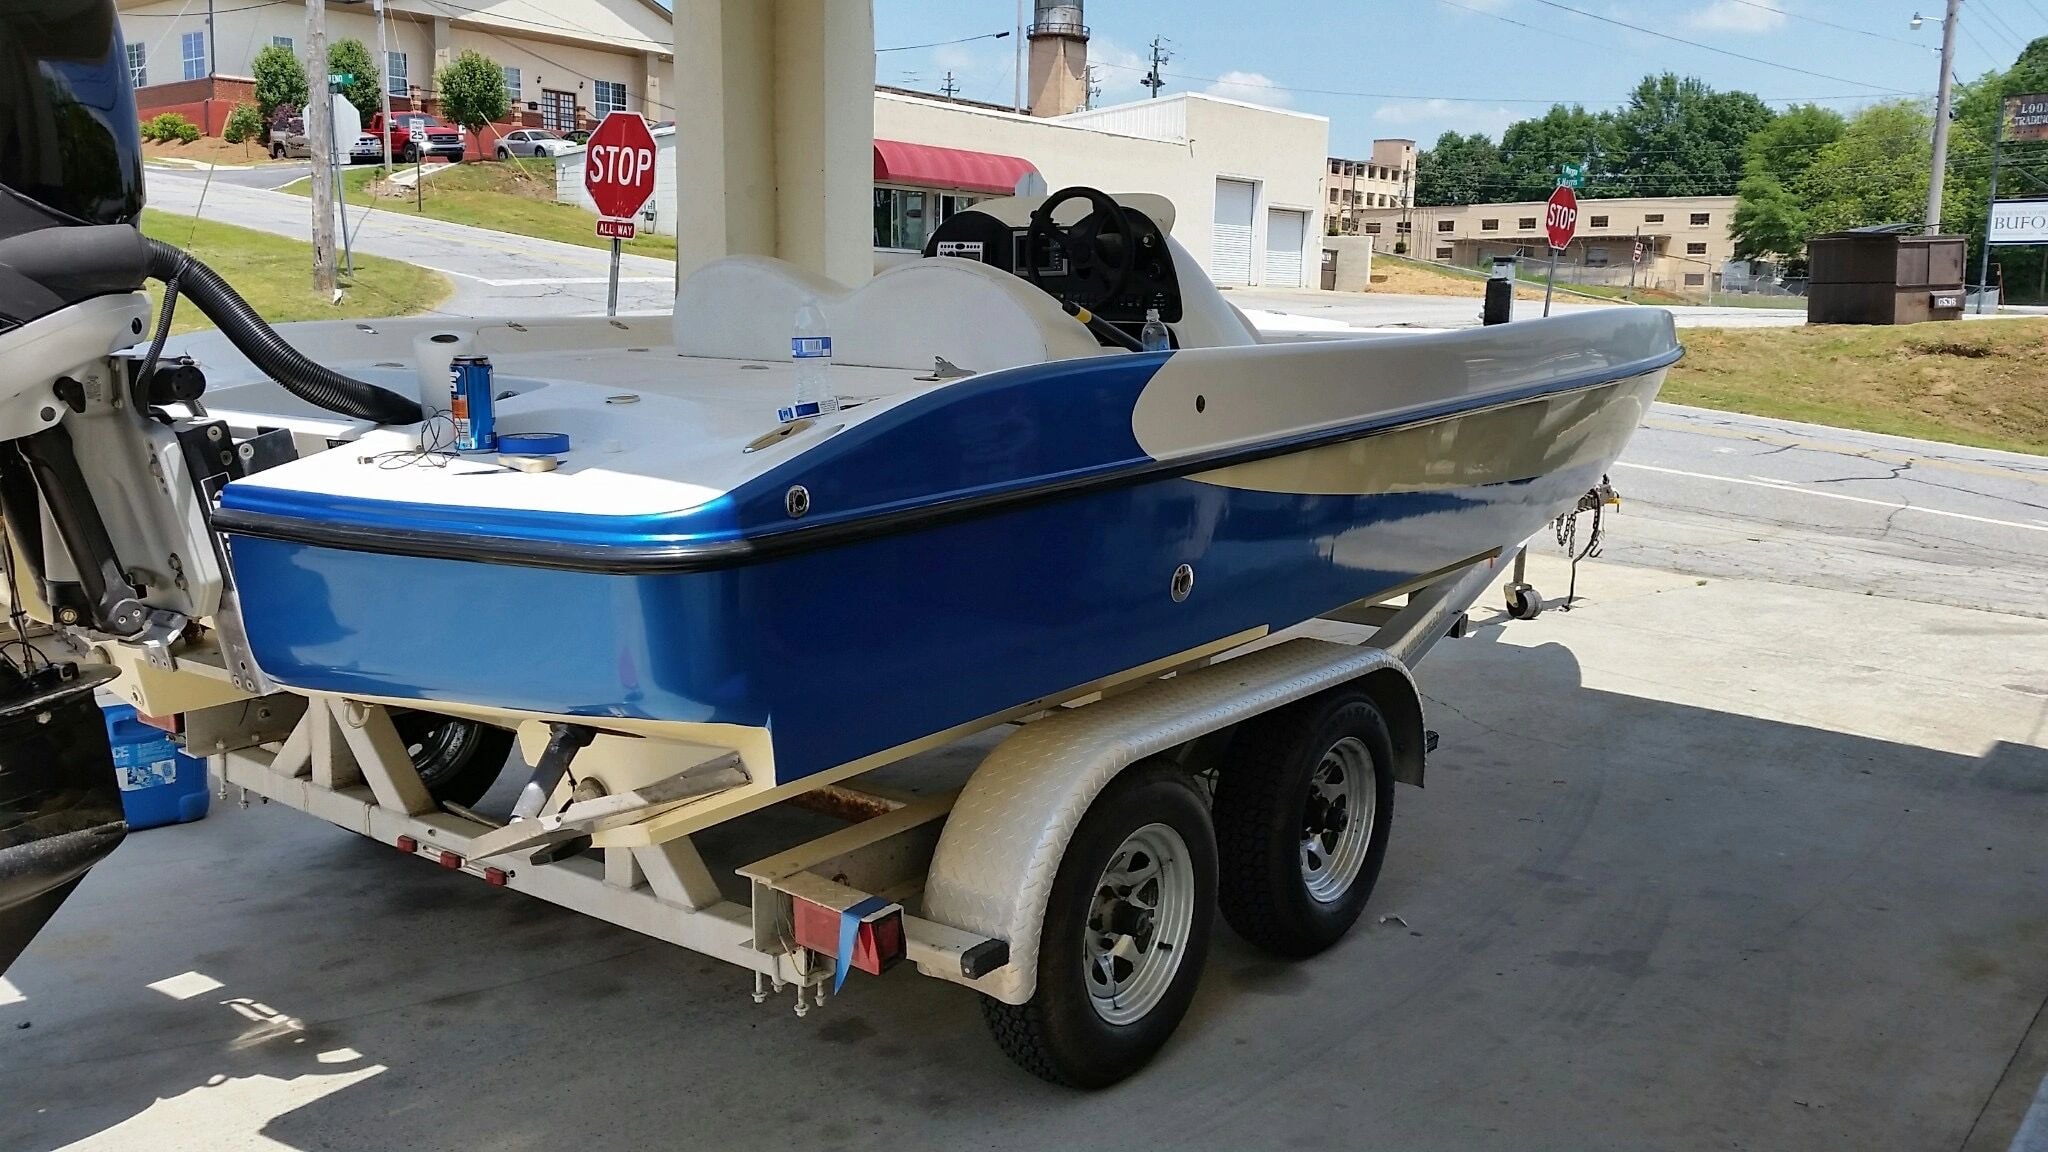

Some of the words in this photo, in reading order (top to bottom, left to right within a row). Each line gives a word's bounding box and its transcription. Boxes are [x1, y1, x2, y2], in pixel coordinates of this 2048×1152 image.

[411, 130, 424, 140] 25
[589, 144, 652, 187] STOP
[1547, 203, 1576, 231] STOP
[1995, 215, 2048, 230] BUFO
[599, 223, 614, 234] ALL
[617, 224, 633, 236] WAY
